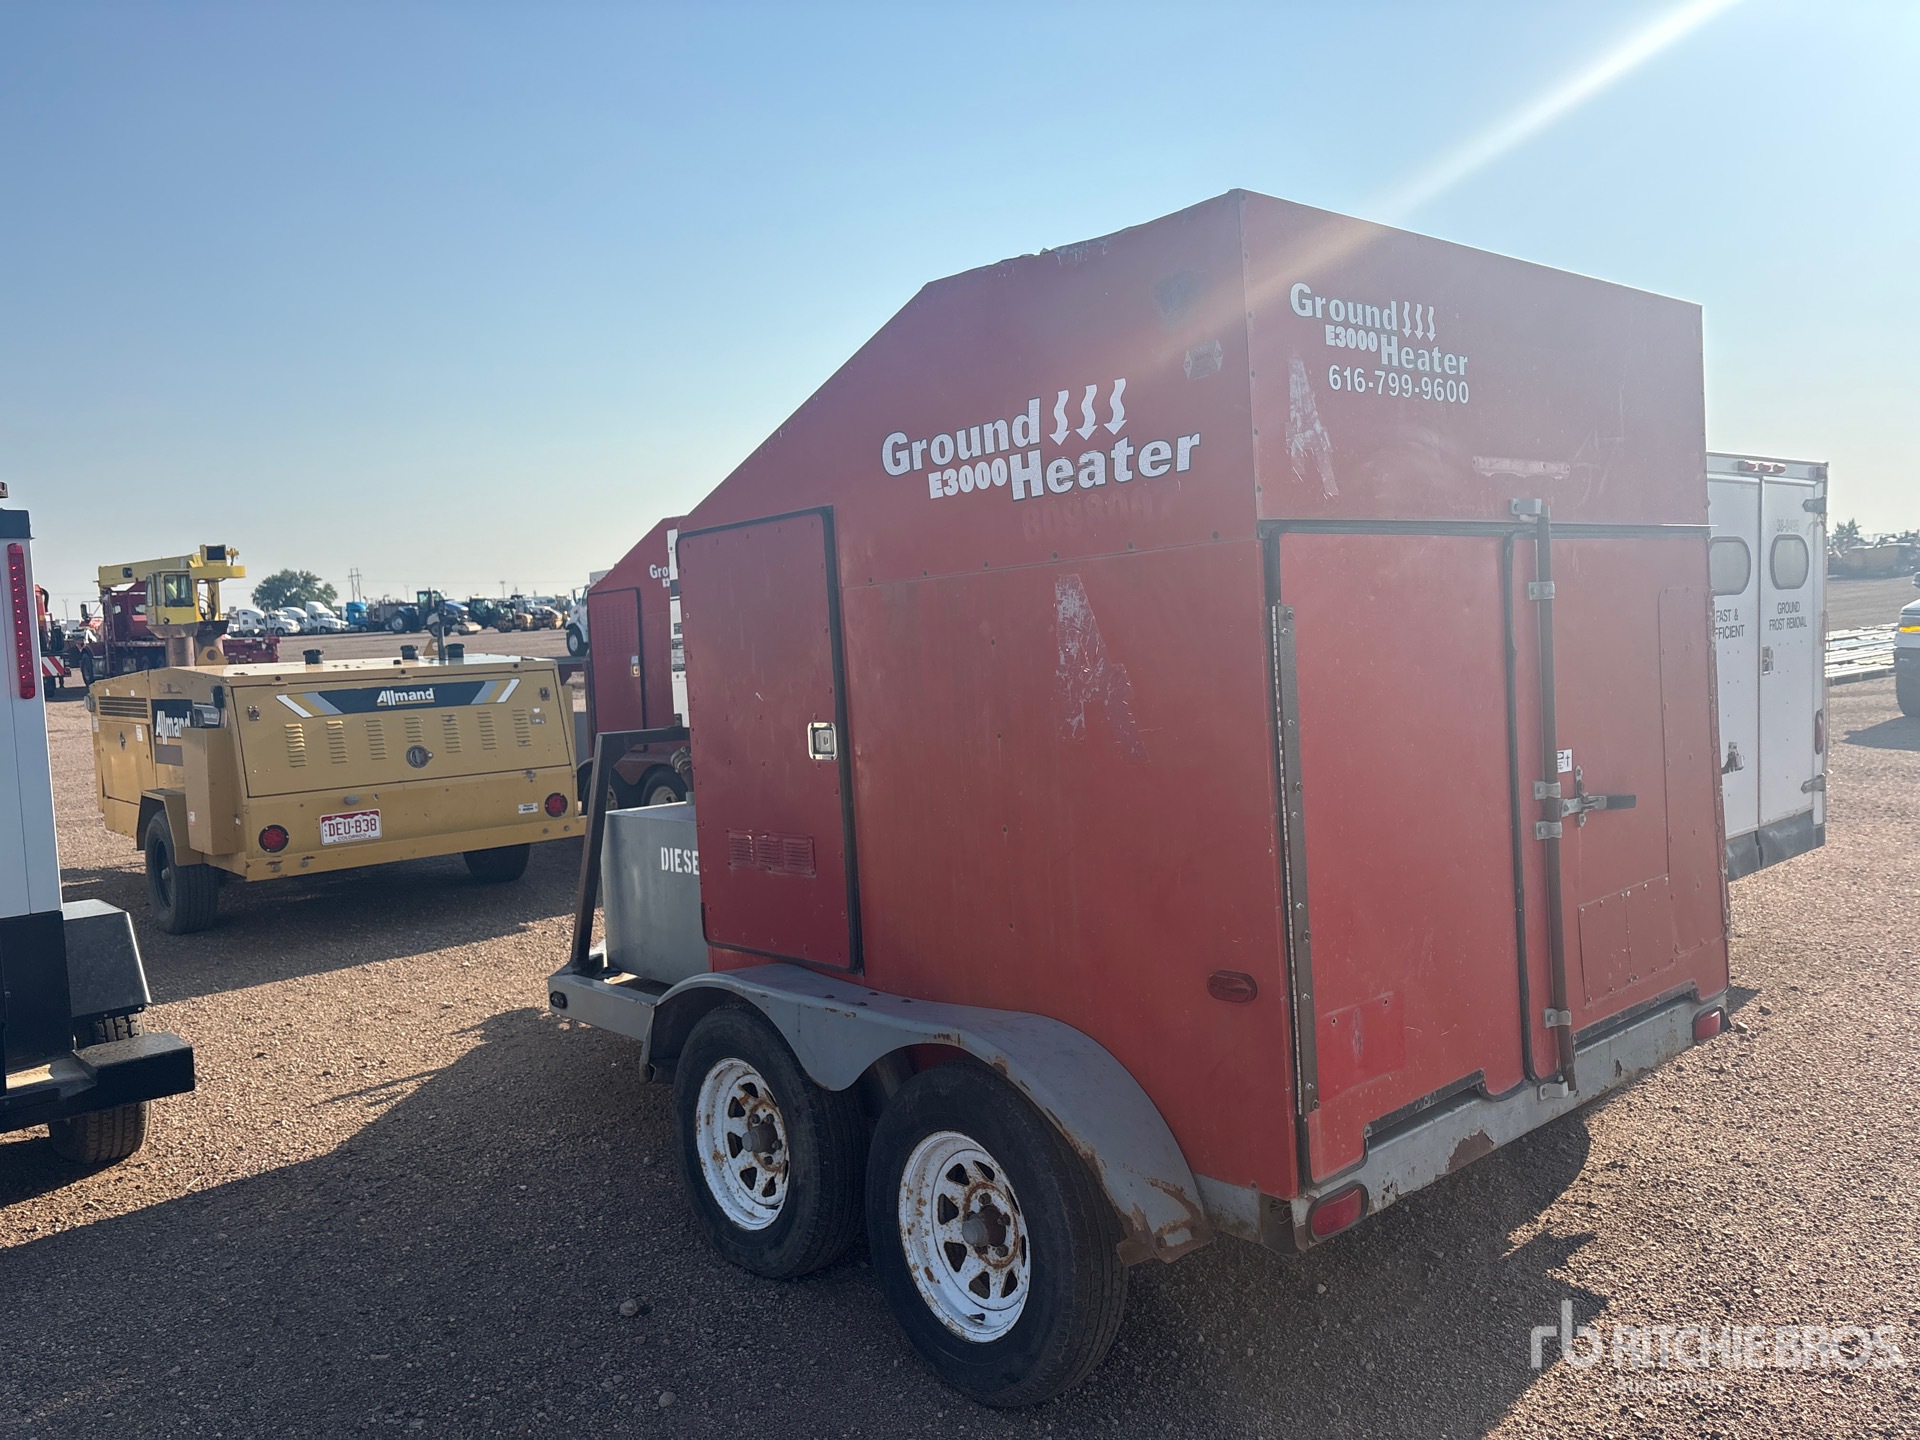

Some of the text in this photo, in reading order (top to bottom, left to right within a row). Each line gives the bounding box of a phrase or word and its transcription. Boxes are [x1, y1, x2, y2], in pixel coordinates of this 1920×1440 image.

[1290, 282, 1398, 332] Ground
[1325, 324, 1469, 377] E3000 Heater
[1328, 364, 1470, 404] 616-799-9600
[881, 397, 1041, 477] Ground
[927, 432, 1202, 502] E3000 Heater
[649, 563, 669, 579] Gro
[1716, 608, 1739, 622] FAST &
[1777, 601, 1800, 614] GROUND
[1715, 624, 1745, 640] FFICIENT
[1769, 616, 1807, 631] FROST REMOVAL
[376, 687, 435, 707] Allmand
[337, 833, 368, 841] COLORADO
[660, 846, 700, 876] DIESE
